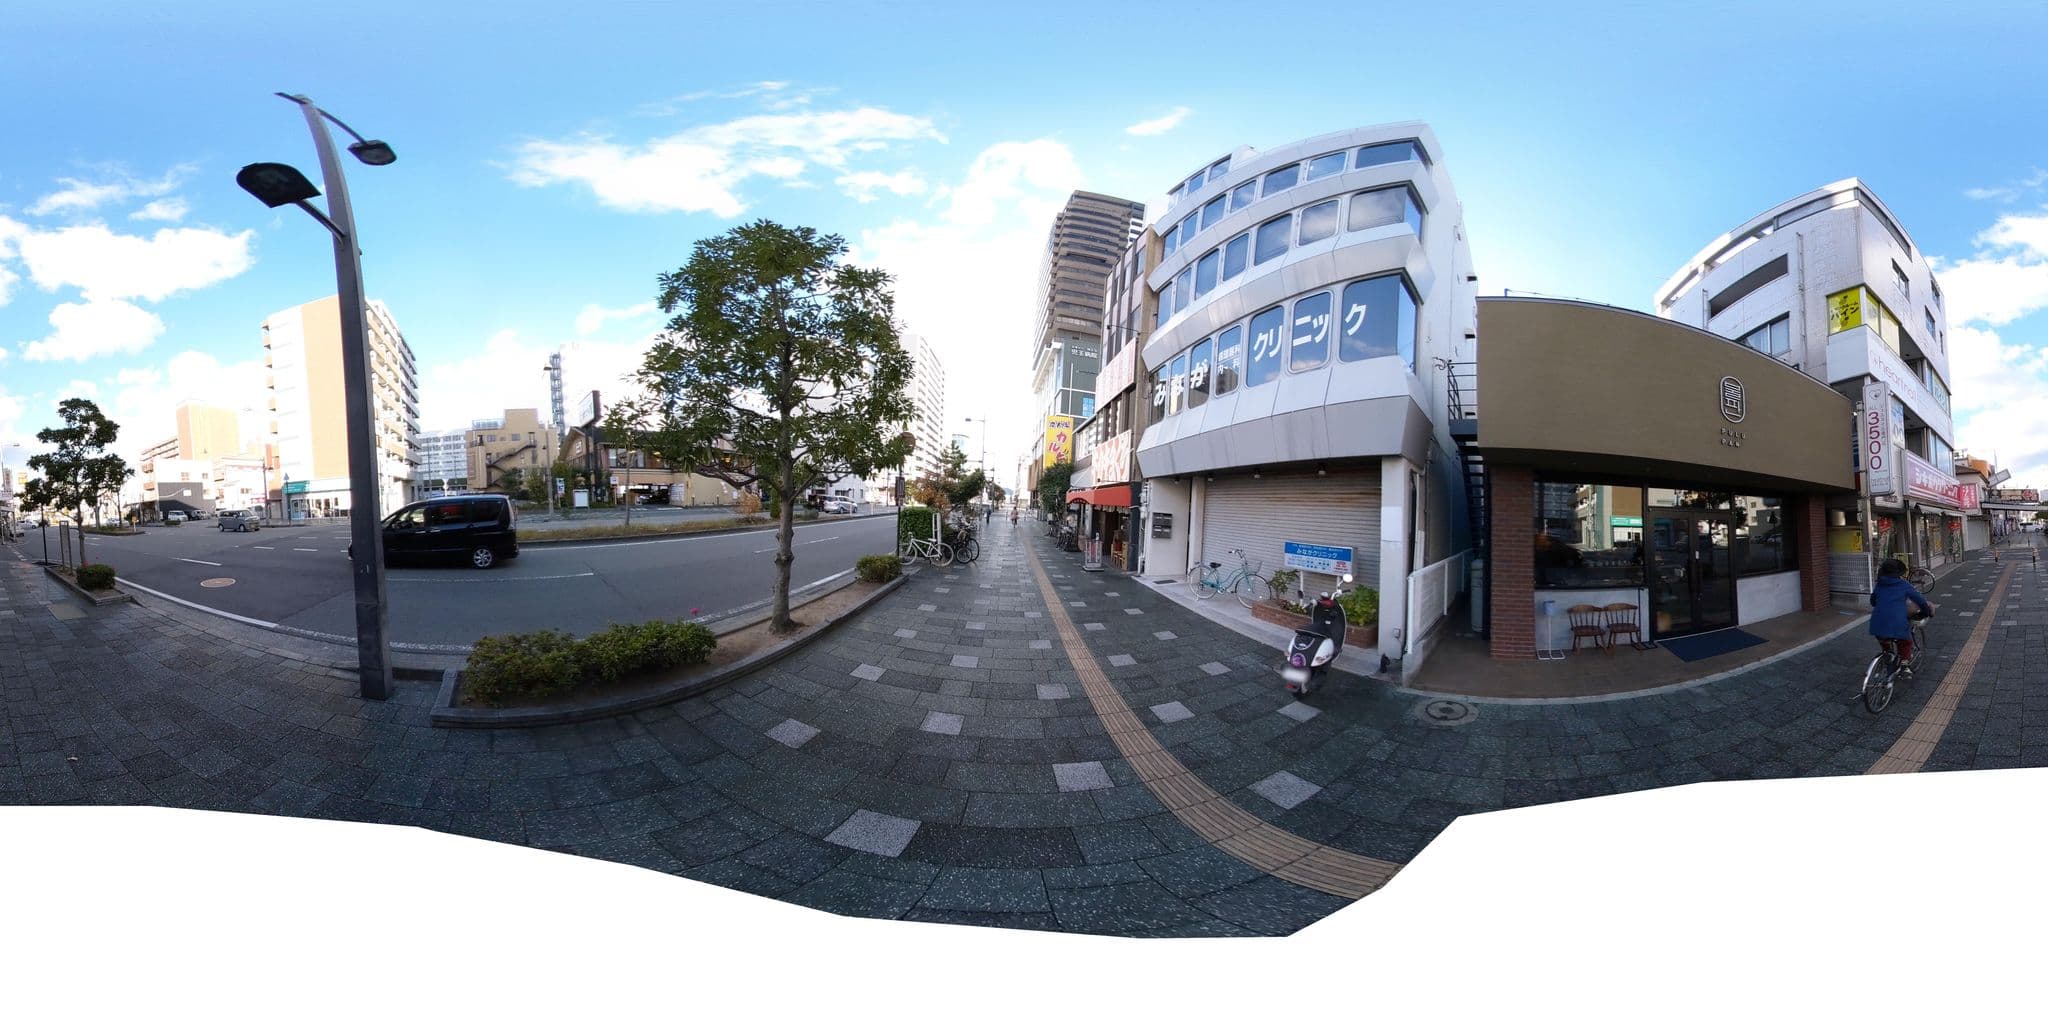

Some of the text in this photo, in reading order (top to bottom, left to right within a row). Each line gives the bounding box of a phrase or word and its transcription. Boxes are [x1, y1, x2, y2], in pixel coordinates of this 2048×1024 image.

[1253, 303, 1367, 362] クリニック
[1868, 411, 1882, 470] 3500
